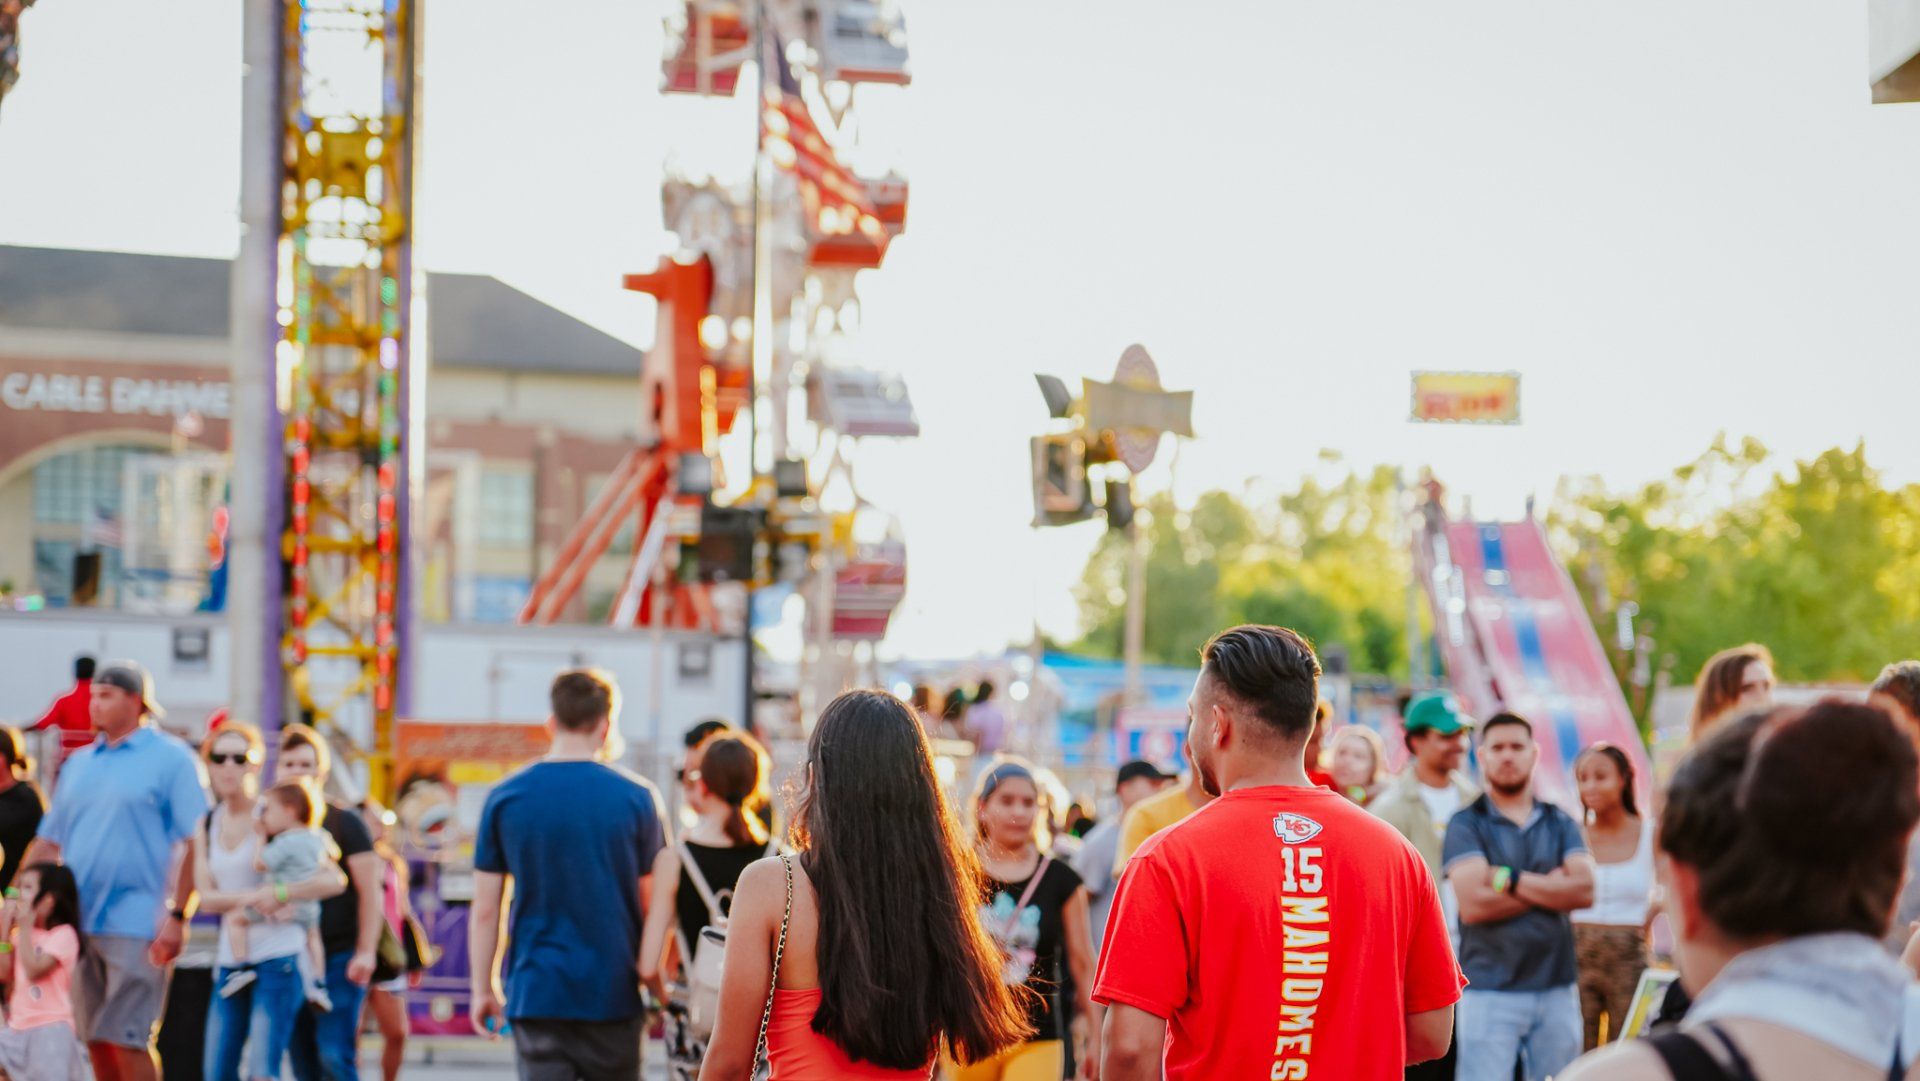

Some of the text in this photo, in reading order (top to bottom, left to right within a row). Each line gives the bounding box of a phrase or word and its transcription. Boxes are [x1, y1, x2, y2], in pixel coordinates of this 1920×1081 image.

[2, 372, 106, 413] CABLE
[1281, 847, 1324, 893] 15
[1270, 896, 1330, 1081] MAHOMES
